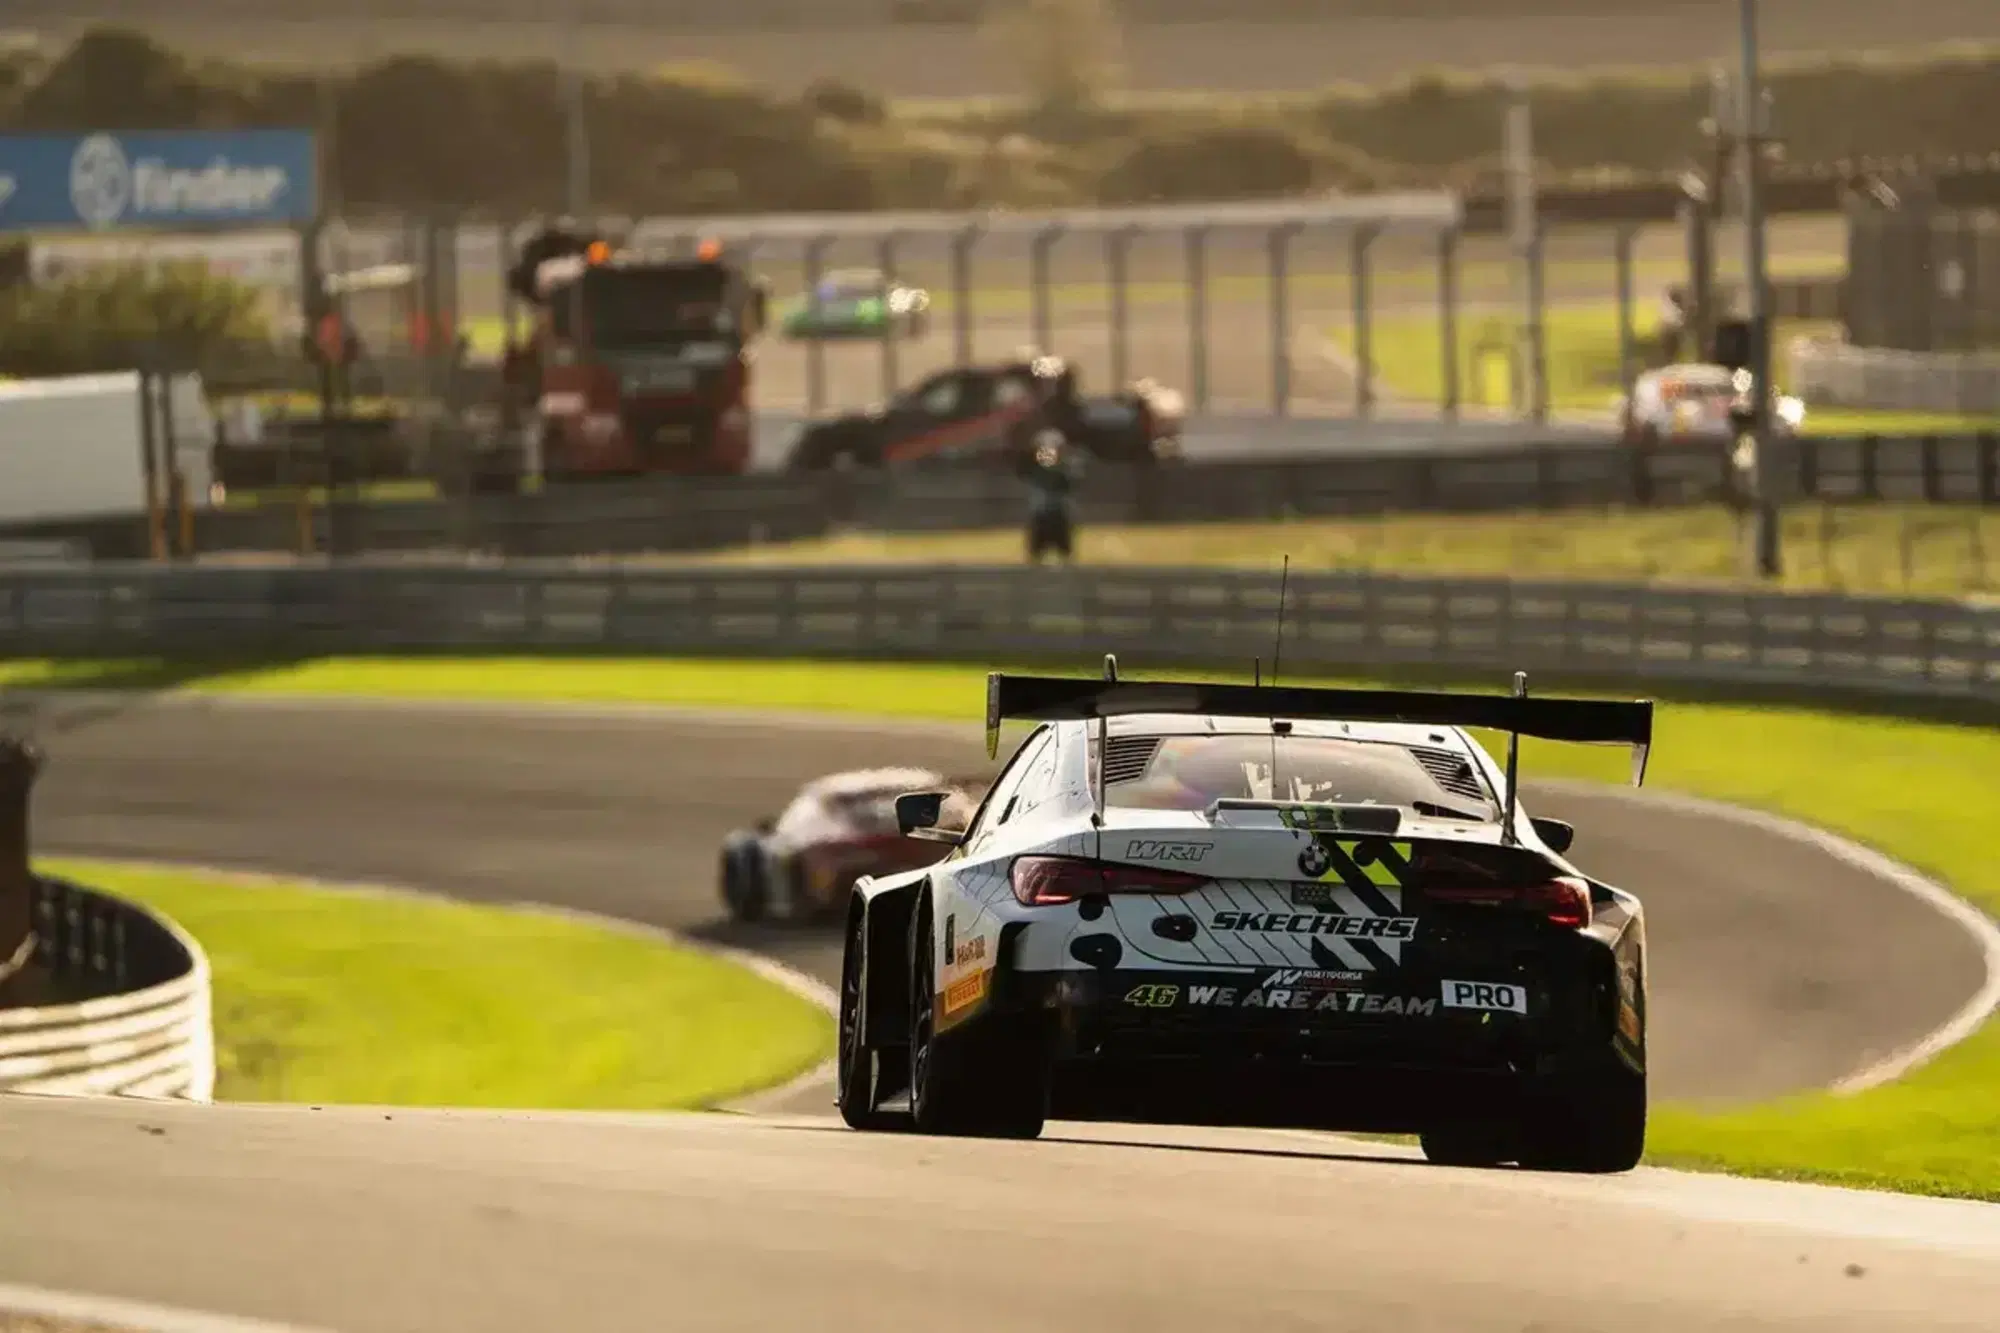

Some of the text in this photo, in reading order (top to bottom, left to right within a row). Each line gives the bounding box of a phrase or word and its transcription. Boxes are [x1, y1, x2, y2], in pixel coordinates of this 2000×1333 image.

[1125, 840, 1214, 861] WRT
[1210, 910, 1419, 942] SKECHERS
[1124, 984, 1180, 1007] 46
[1188, 985, 1438, 1017] WE ARE A TEAM
[1455, 982, 1515, 1008] PRO
